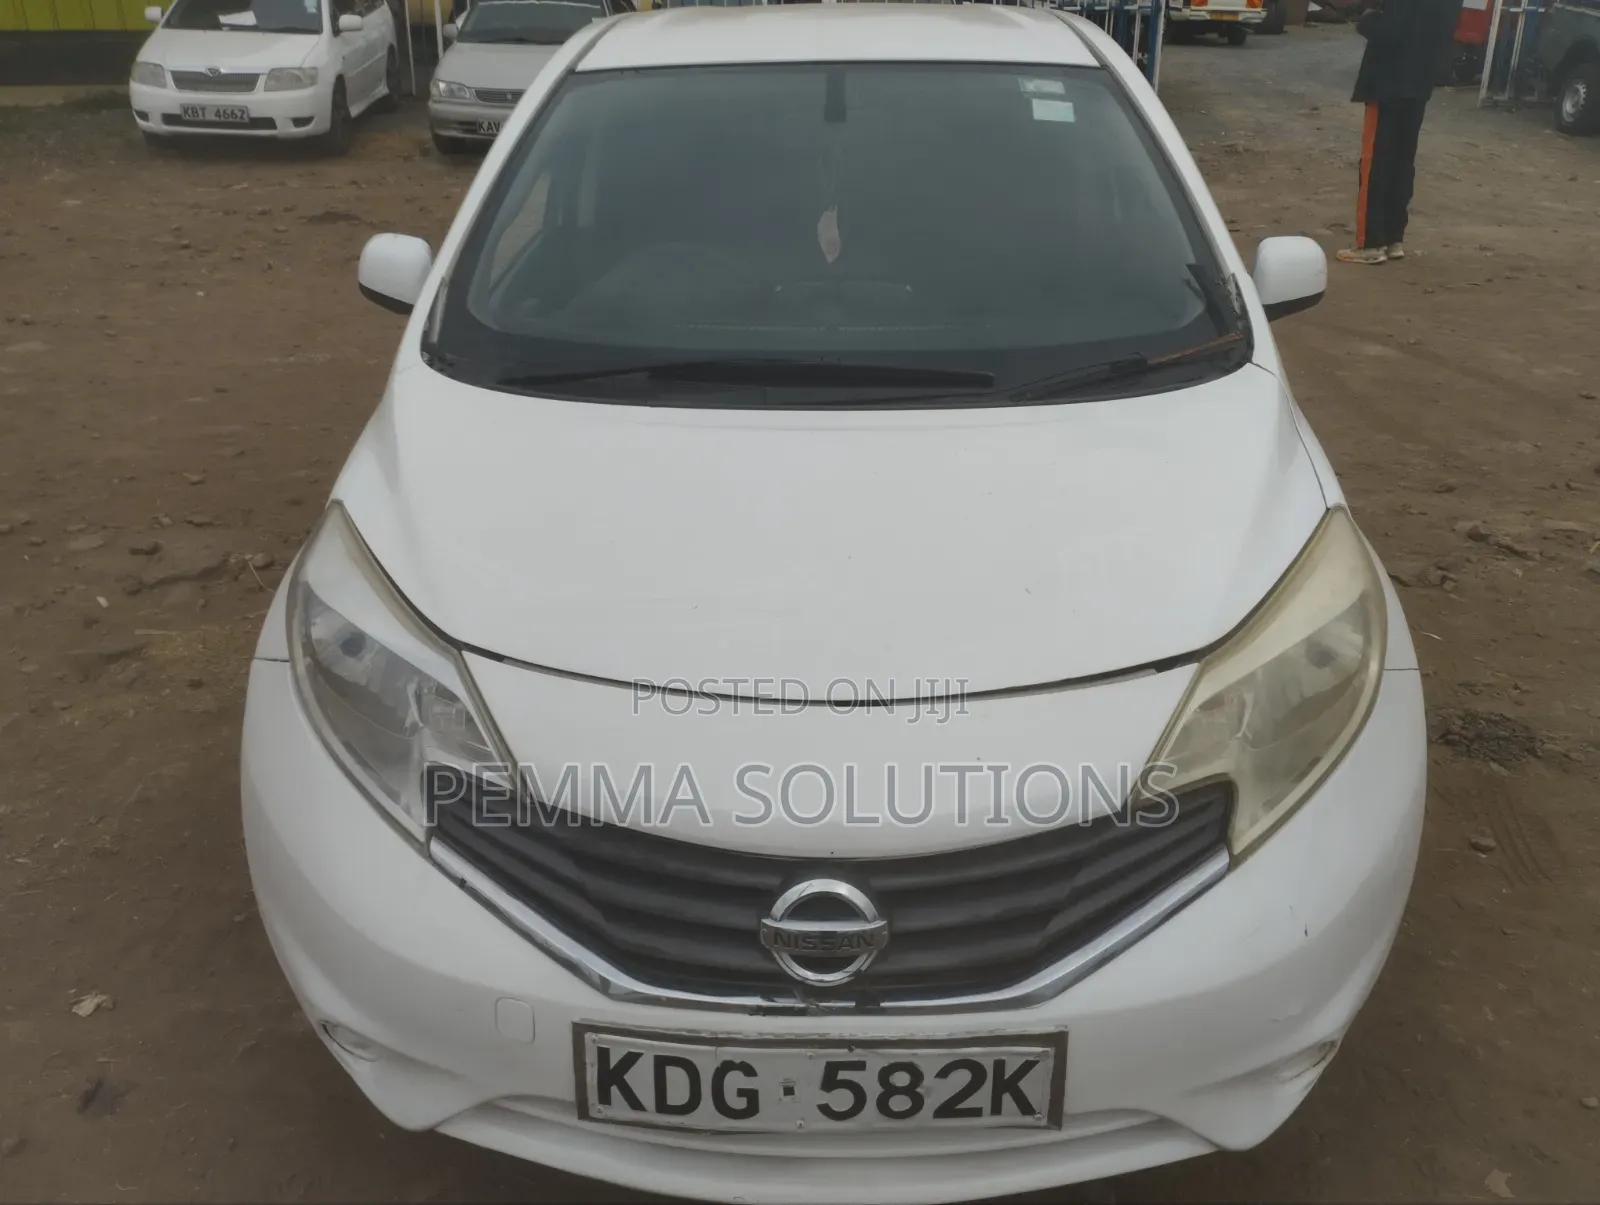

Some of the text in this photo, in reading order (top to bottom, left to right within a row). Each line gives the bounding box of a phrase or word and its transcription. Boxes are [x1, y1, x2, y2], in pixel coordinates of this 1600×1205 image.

[182, 106, 206, 120] KBT
[774, 931, 876, 951] NISSAN
[596, 1046, 1041, 1122] KDG 582K
